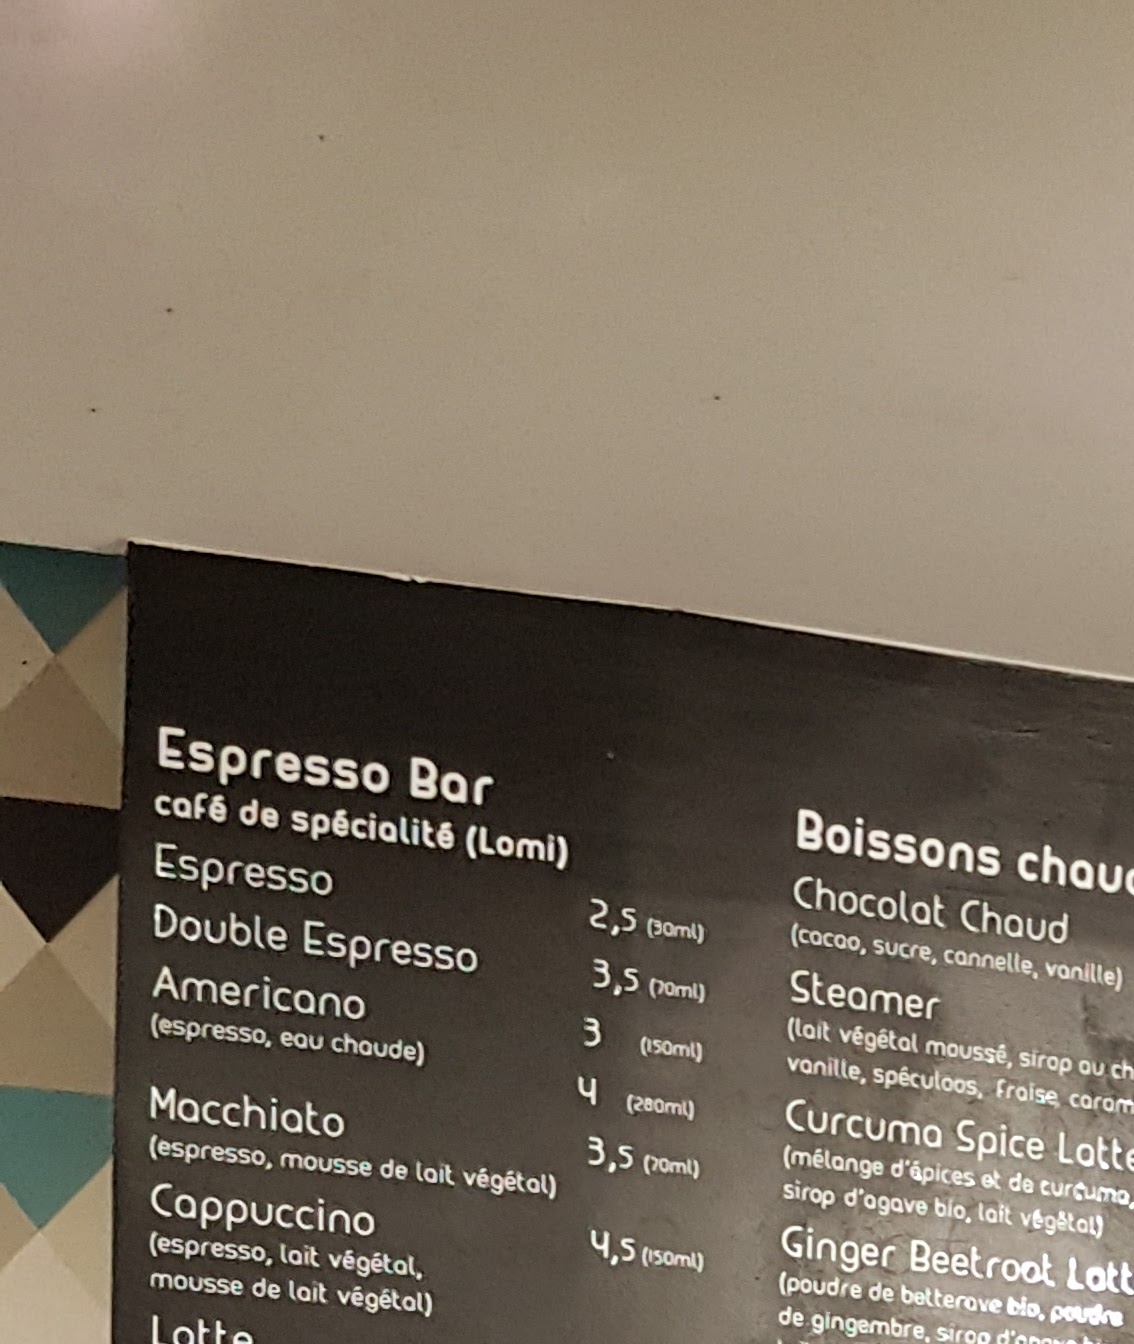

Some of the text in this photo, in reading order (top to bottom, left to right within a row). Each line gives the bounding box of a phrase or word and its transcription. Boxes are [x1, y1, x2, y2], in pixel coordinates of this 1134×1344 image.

[157, 725, 495, 806] Espresso Bar
[153, 791, 569, 871] café de spécialité (Lomi)
[796, 808, 1001, 877] Boissons
[154, 841, 333, 896] Espresso
[153, 902, 478, 973] Double Espresso
[589, 897, 705, 945] 2,5 (30ml)
[793, 875, 1069, 944] Chocolat Chaud
[790, 922, 1123, 992] (cacao, sucre, cannelle, vanille)
[152, 965, 366, 1020] Americano
[790, 969, 941, 1020] Steamer
[150, 1012, 425, 1067] (espresso, eau chaude)
[150, 1085, 345, 1138] Macchiato
[785, 1098, 943, 1148] Curcuma
[956, 1119, 1045, 1162] Spice
[149, 1134, 557, 1200] (espresso, mousse de lait végétal)
[783, 1144, 884, 1180] (mélange
[981, 1170, 1001, 1190] et
[1008, 1172, 1034, 1194] de
[150, 1182, 375, 1236] Cappuccino
[590, 1229, 704, 1273] 4,5 (150ml)
[781, 1225, 897, 1273] Ginger
[910, 1239, 1056, 1288] Beetroot
